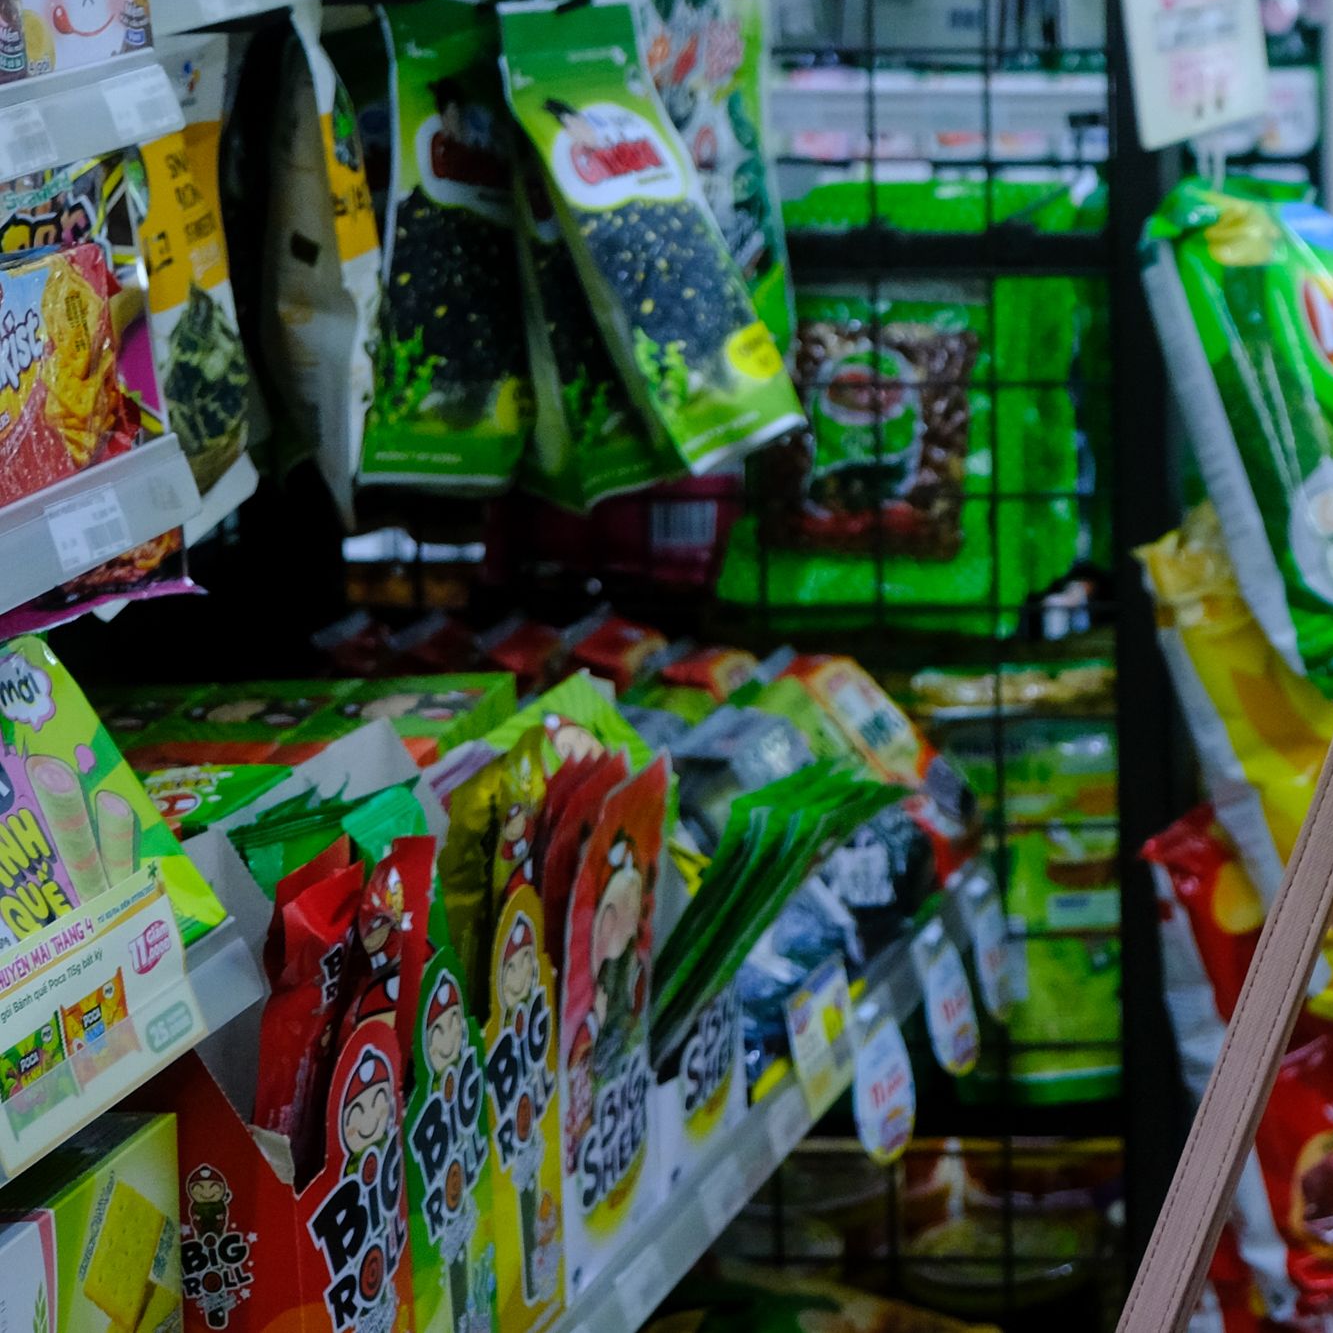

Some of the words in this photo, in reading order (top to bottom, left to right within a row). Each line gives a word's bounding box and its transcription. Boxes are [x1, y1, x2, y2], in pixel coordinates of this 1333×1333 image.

[0, 807, 52, 889] NH
[49, 920, 86, 957] THÁNG
[85, 916, 95, 935] 4
[12, 993, 34, 1014] Bánh
[48, 972, 68, 991] Poca
